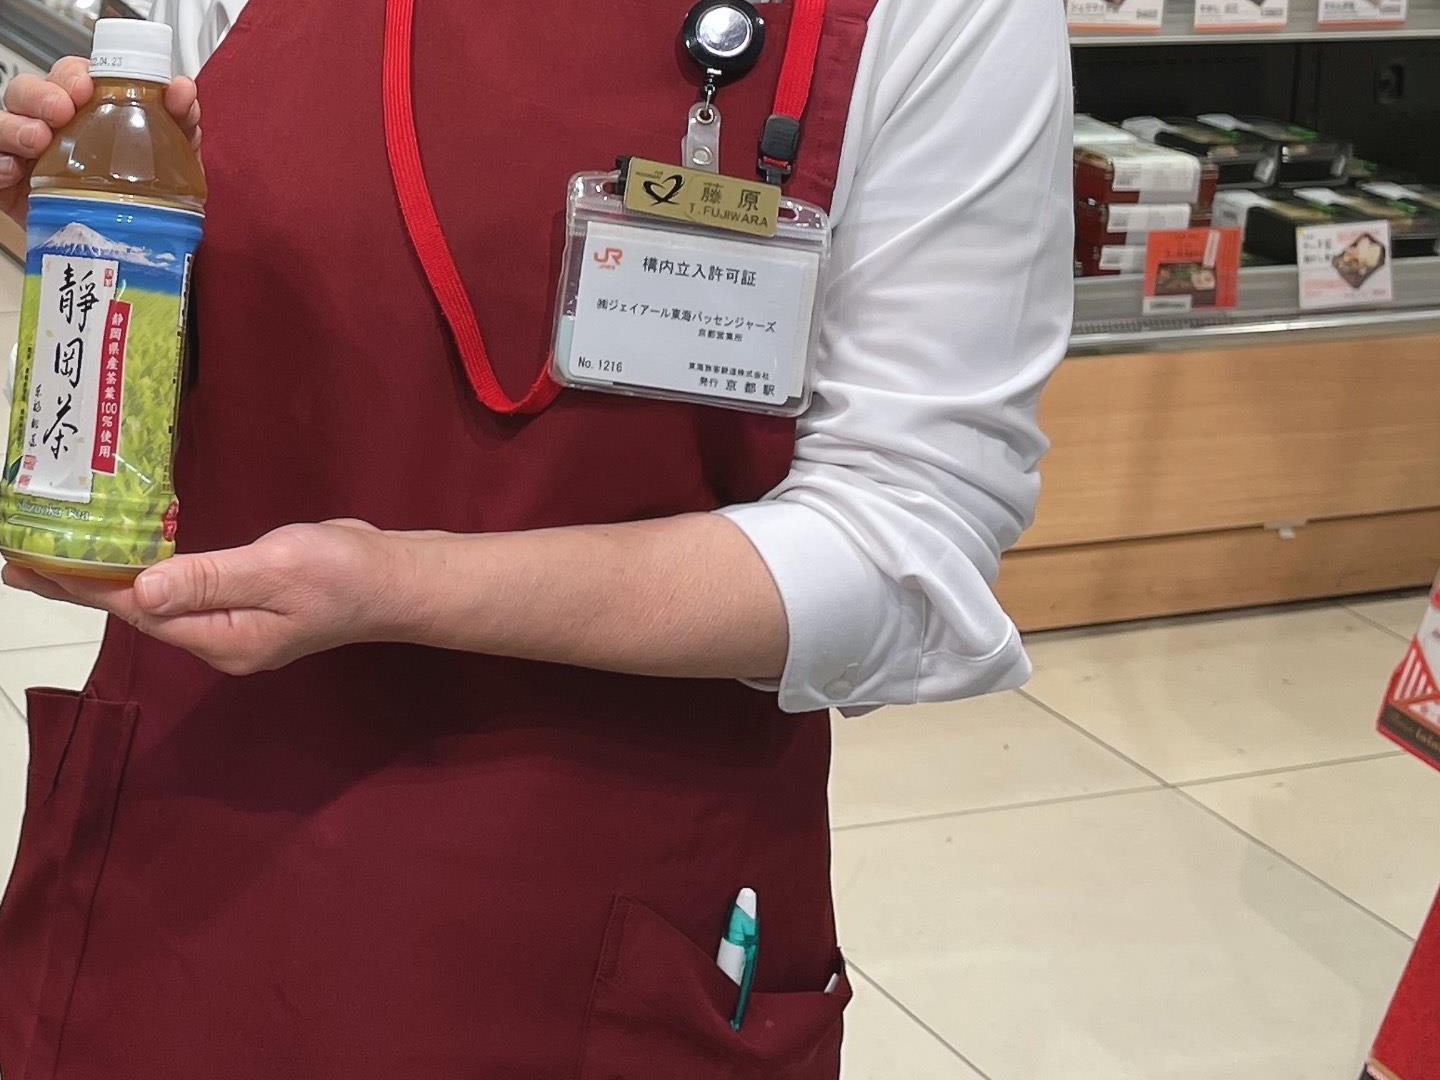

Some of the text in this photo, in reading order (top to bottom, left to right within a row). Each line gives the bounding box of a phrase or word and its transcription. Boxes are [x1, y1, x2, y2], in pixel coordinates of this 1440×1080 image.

[701, 182, 761, 211] 藤原
[593, 247, 624, 265] JR
[642, 256, 757, 286] 構内立入許可証
